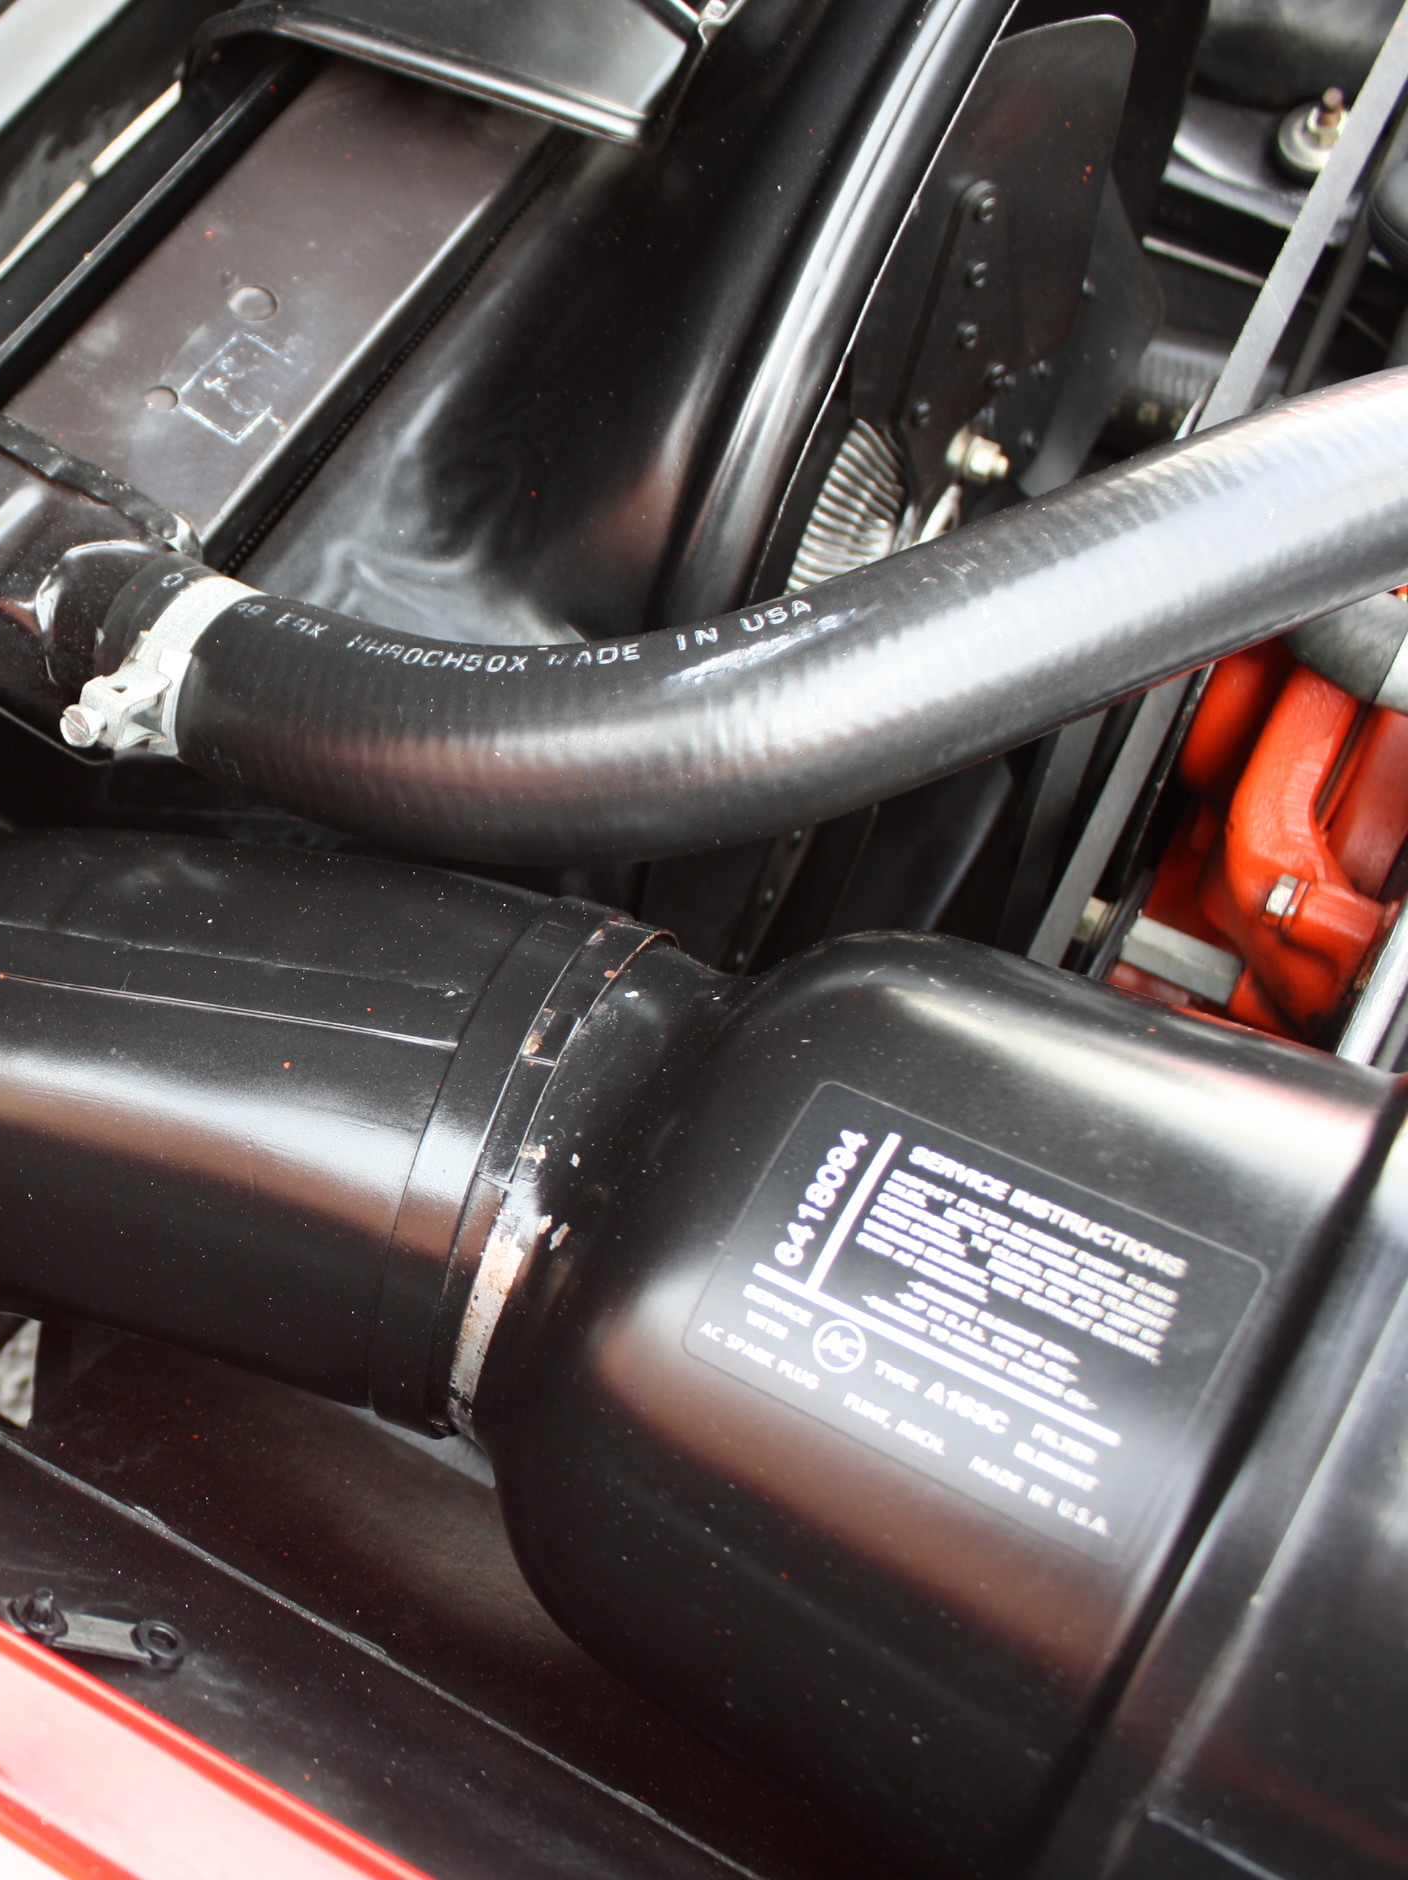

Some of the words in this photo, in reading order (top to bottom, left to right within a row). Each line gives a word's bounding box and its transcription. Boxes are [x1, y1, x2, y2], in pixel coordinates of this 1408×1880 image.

[675, 627, 718, 651] IN
[739, 600, 813, 632] USA
[774, 1128, 868, 1267] 6418094
[909, 1147, 1011, 1200] SERVICE
[1009, 1189, 1186, 1277] INSTRUCTIONS
[743, 1284, 814, 1327] SERVICE
[747, 1310, 789, 1340] WITH
[818, 1331, 862, 1360] AC
[875, 1360, 919, 1392] TYPE
[699, 1323, 724, 1341] AC
[725, 1334, 776, 1368] SPARK
[777, 1360, 820, 1390] PLUG
[969, 1456, 1025, 1492] MADE
[1028, 1485, 1053, 1506] IN
[1014, 1442, 1098, 1490] ELEMENT
[1031, 1424, 1097, 1464] FILTER
